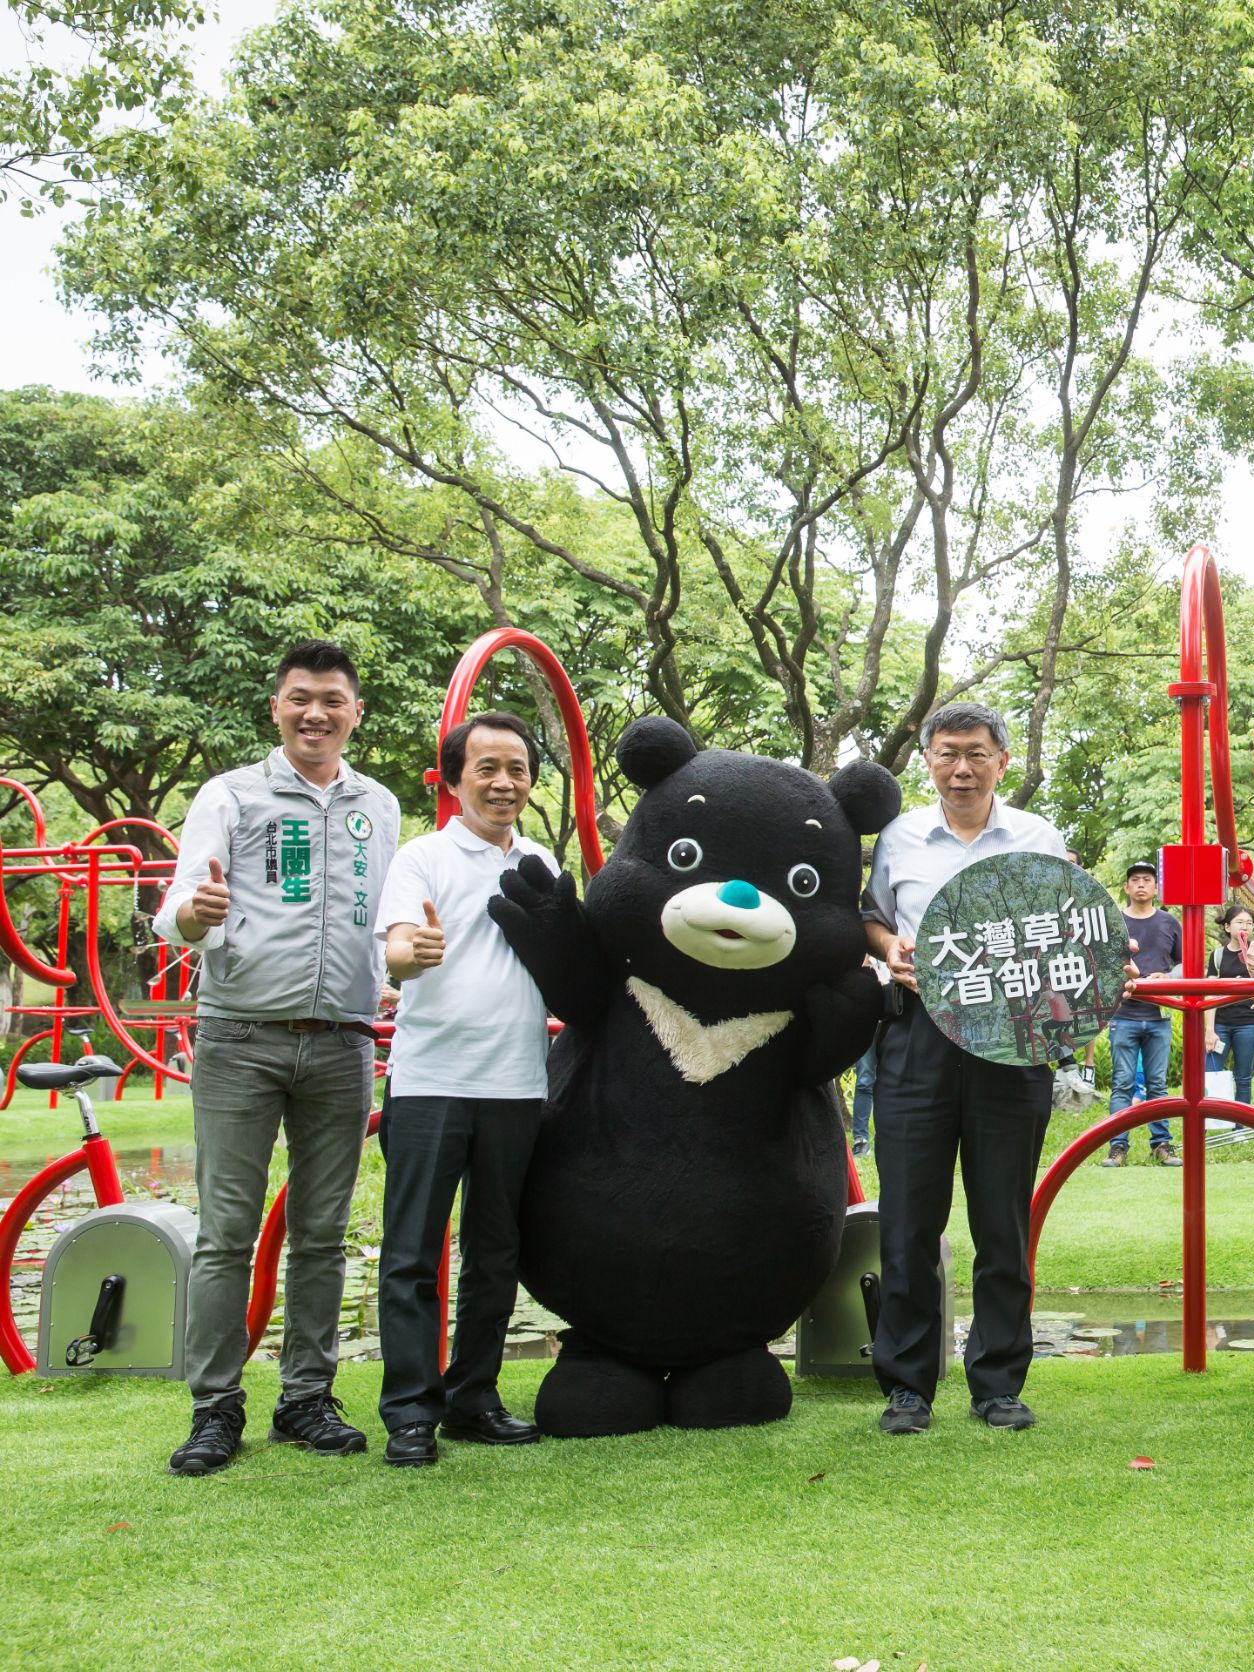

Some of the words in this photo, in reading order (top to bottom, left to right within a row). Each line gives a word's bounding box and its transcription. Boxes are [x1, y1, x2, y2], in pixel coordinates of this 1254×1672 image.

[265, 820, 278, 884] 台北市議員
[281, 819, 312, 902] 王閔生
[928, 896, 1109, 969] 大灣草圳
[940, 951, 1094, 1006] 首部曲
